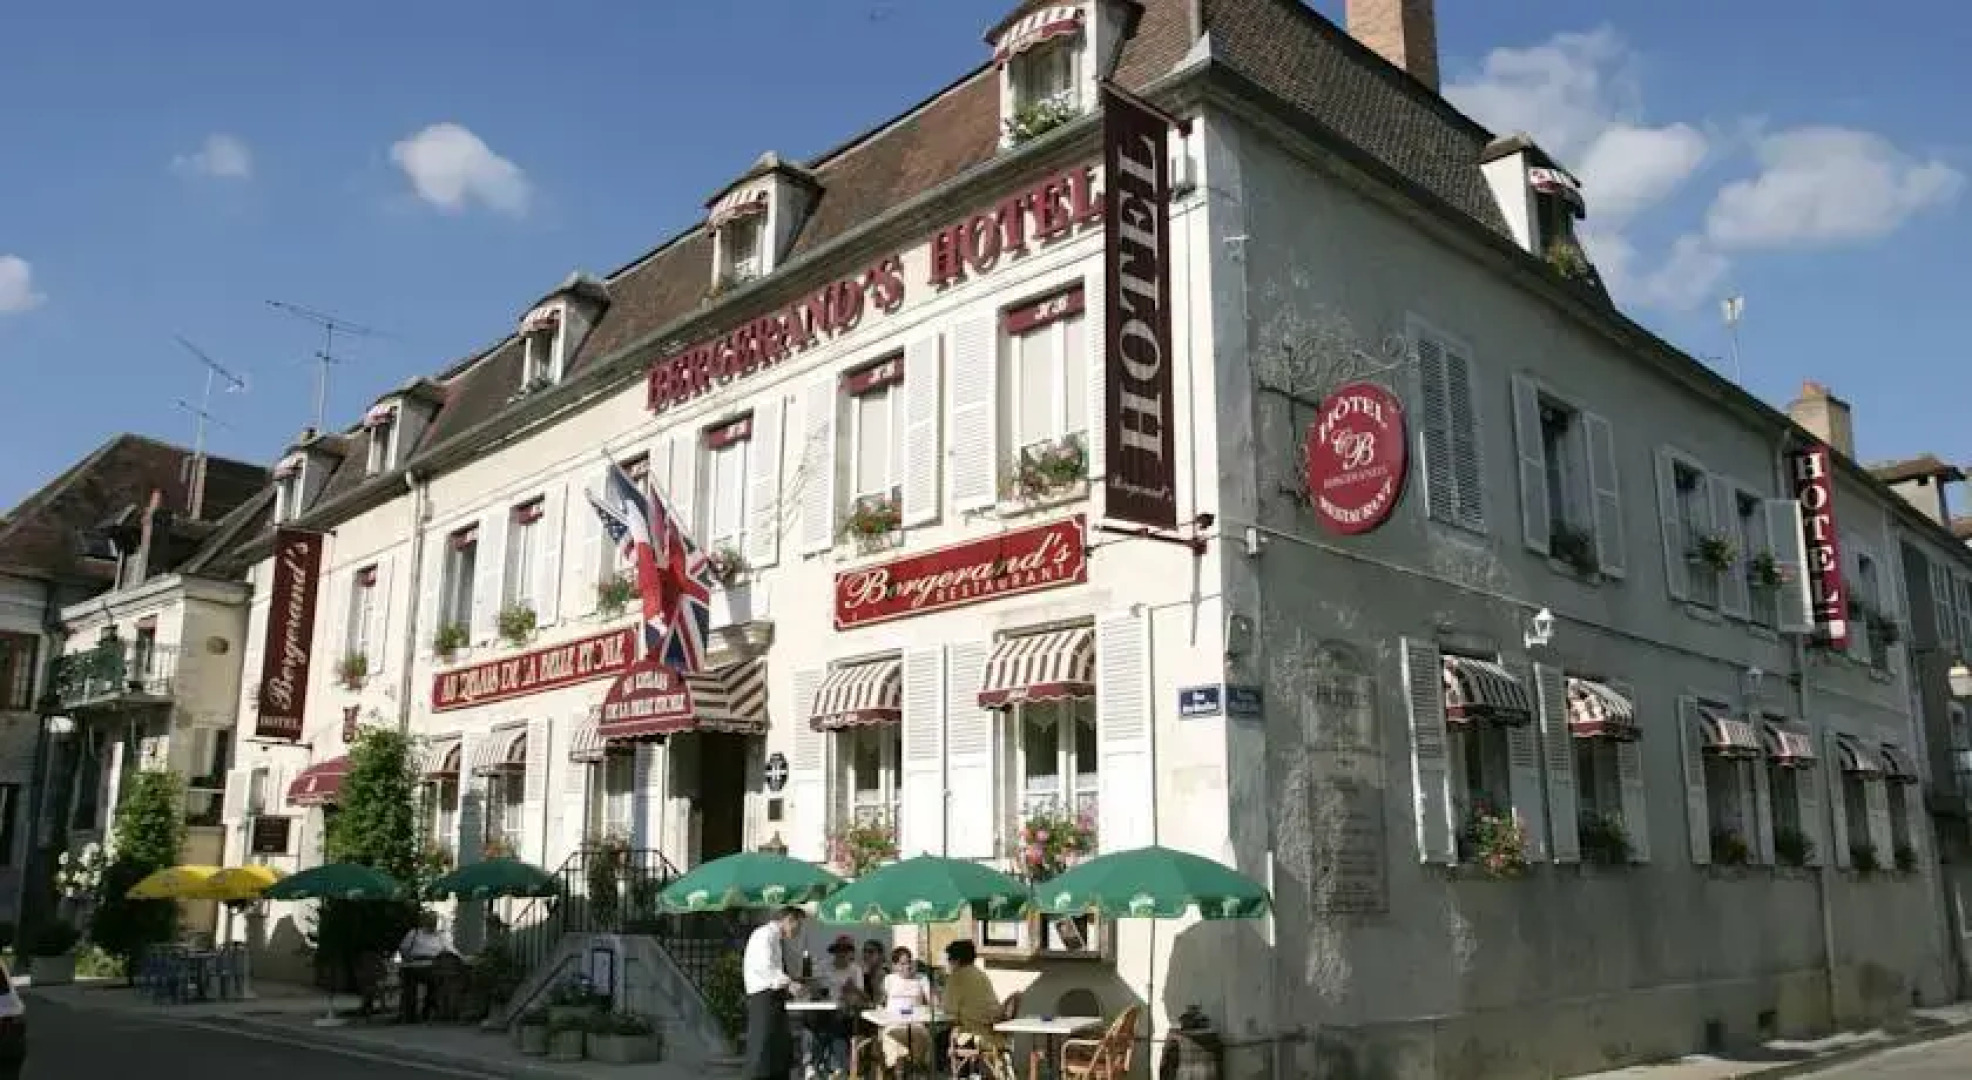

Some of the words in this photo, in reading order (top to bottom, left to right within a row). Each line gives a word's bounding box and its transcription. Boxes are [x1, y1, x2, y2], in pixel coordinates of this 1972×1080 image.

[646, 254, 905, 415] BERGERAND'S
[927, 164, 1106, 292] HOTEL
[1119, 135, 1163, 462] HOTEL
[935, 564, 1065, 602] RESTAURANT
[1796, 452, 1839, 602] HOTEL
